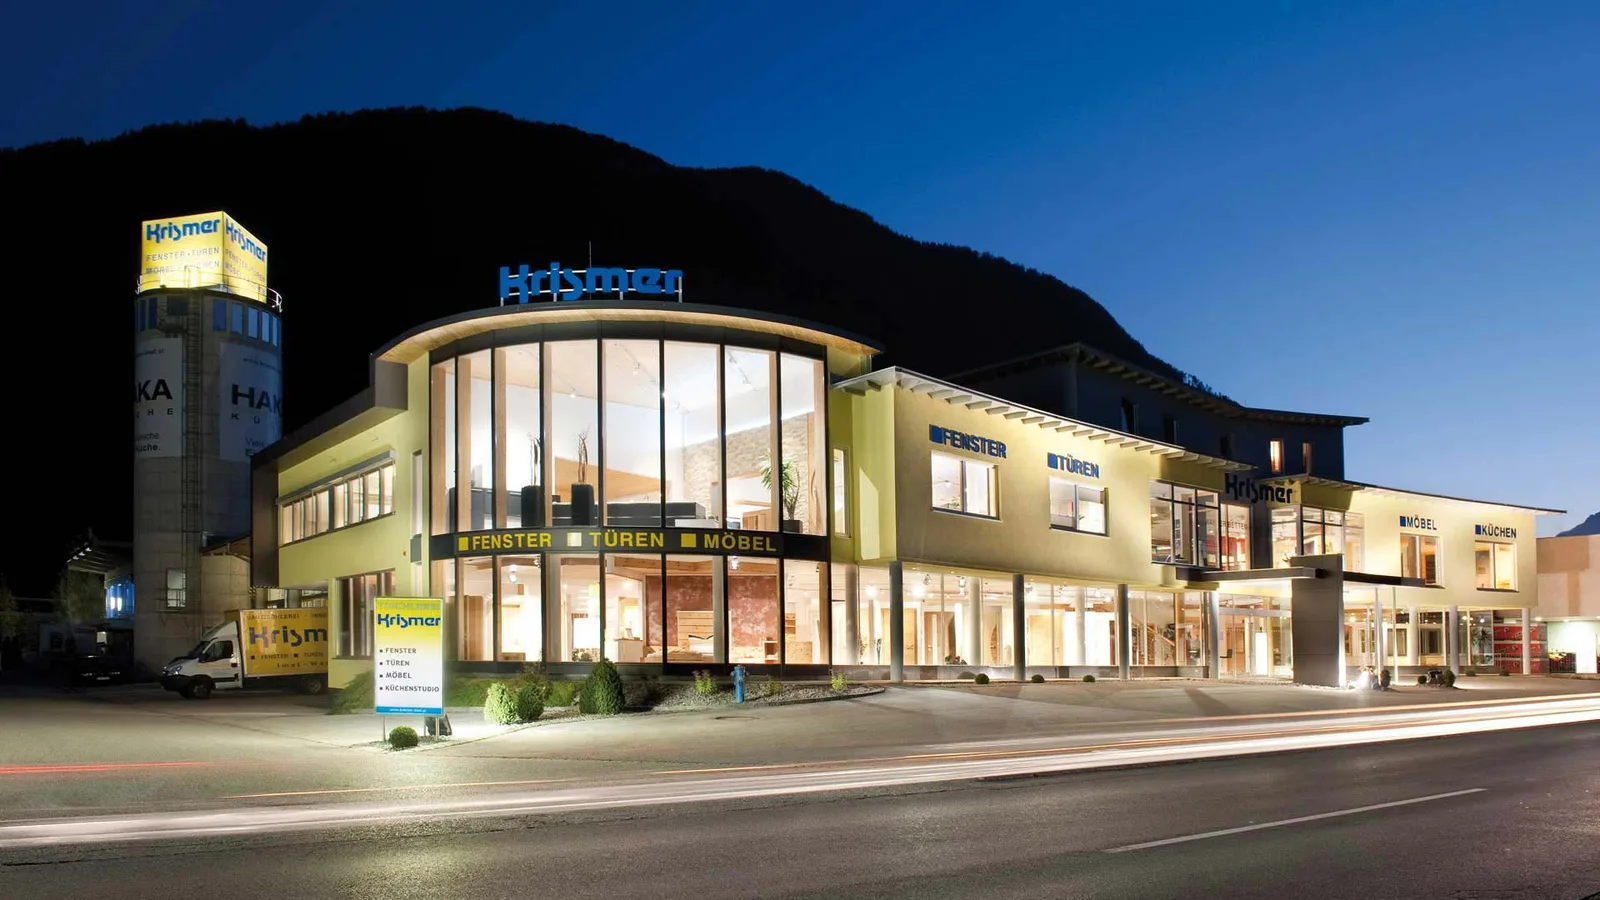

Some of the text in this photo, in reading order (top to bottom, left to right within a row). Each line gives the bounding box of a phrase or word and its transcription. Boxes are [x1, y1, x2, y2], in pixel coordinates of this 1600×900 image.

[146, 219, 220, 244] Krismer
[225, 218, 266, 262] Krismer
[146, 251, 185, 262] FENSTER
[499, 262, 682, 304] Krismer
[134, 378, 174, 404] KA
[942, 428, 1007, 459] FENSTER
[1058, 453, 1099, 479] TÜREN
[1225, 472, 1293, 504] Krismer
[1406, 515, 1437, 531] MÖBEL
[1481, 522, 1517, 539] KÜCHEN
[472, 529, 777, 552] FENSTER TÜREN MÖBEL
[377, 613, 441, 628] Krismer
[249, 625, 328, 648] Krism
[385, 671, 412, 679] MÖBEL
[385, 684, 440, 693] KÜCHENSTUDIO
